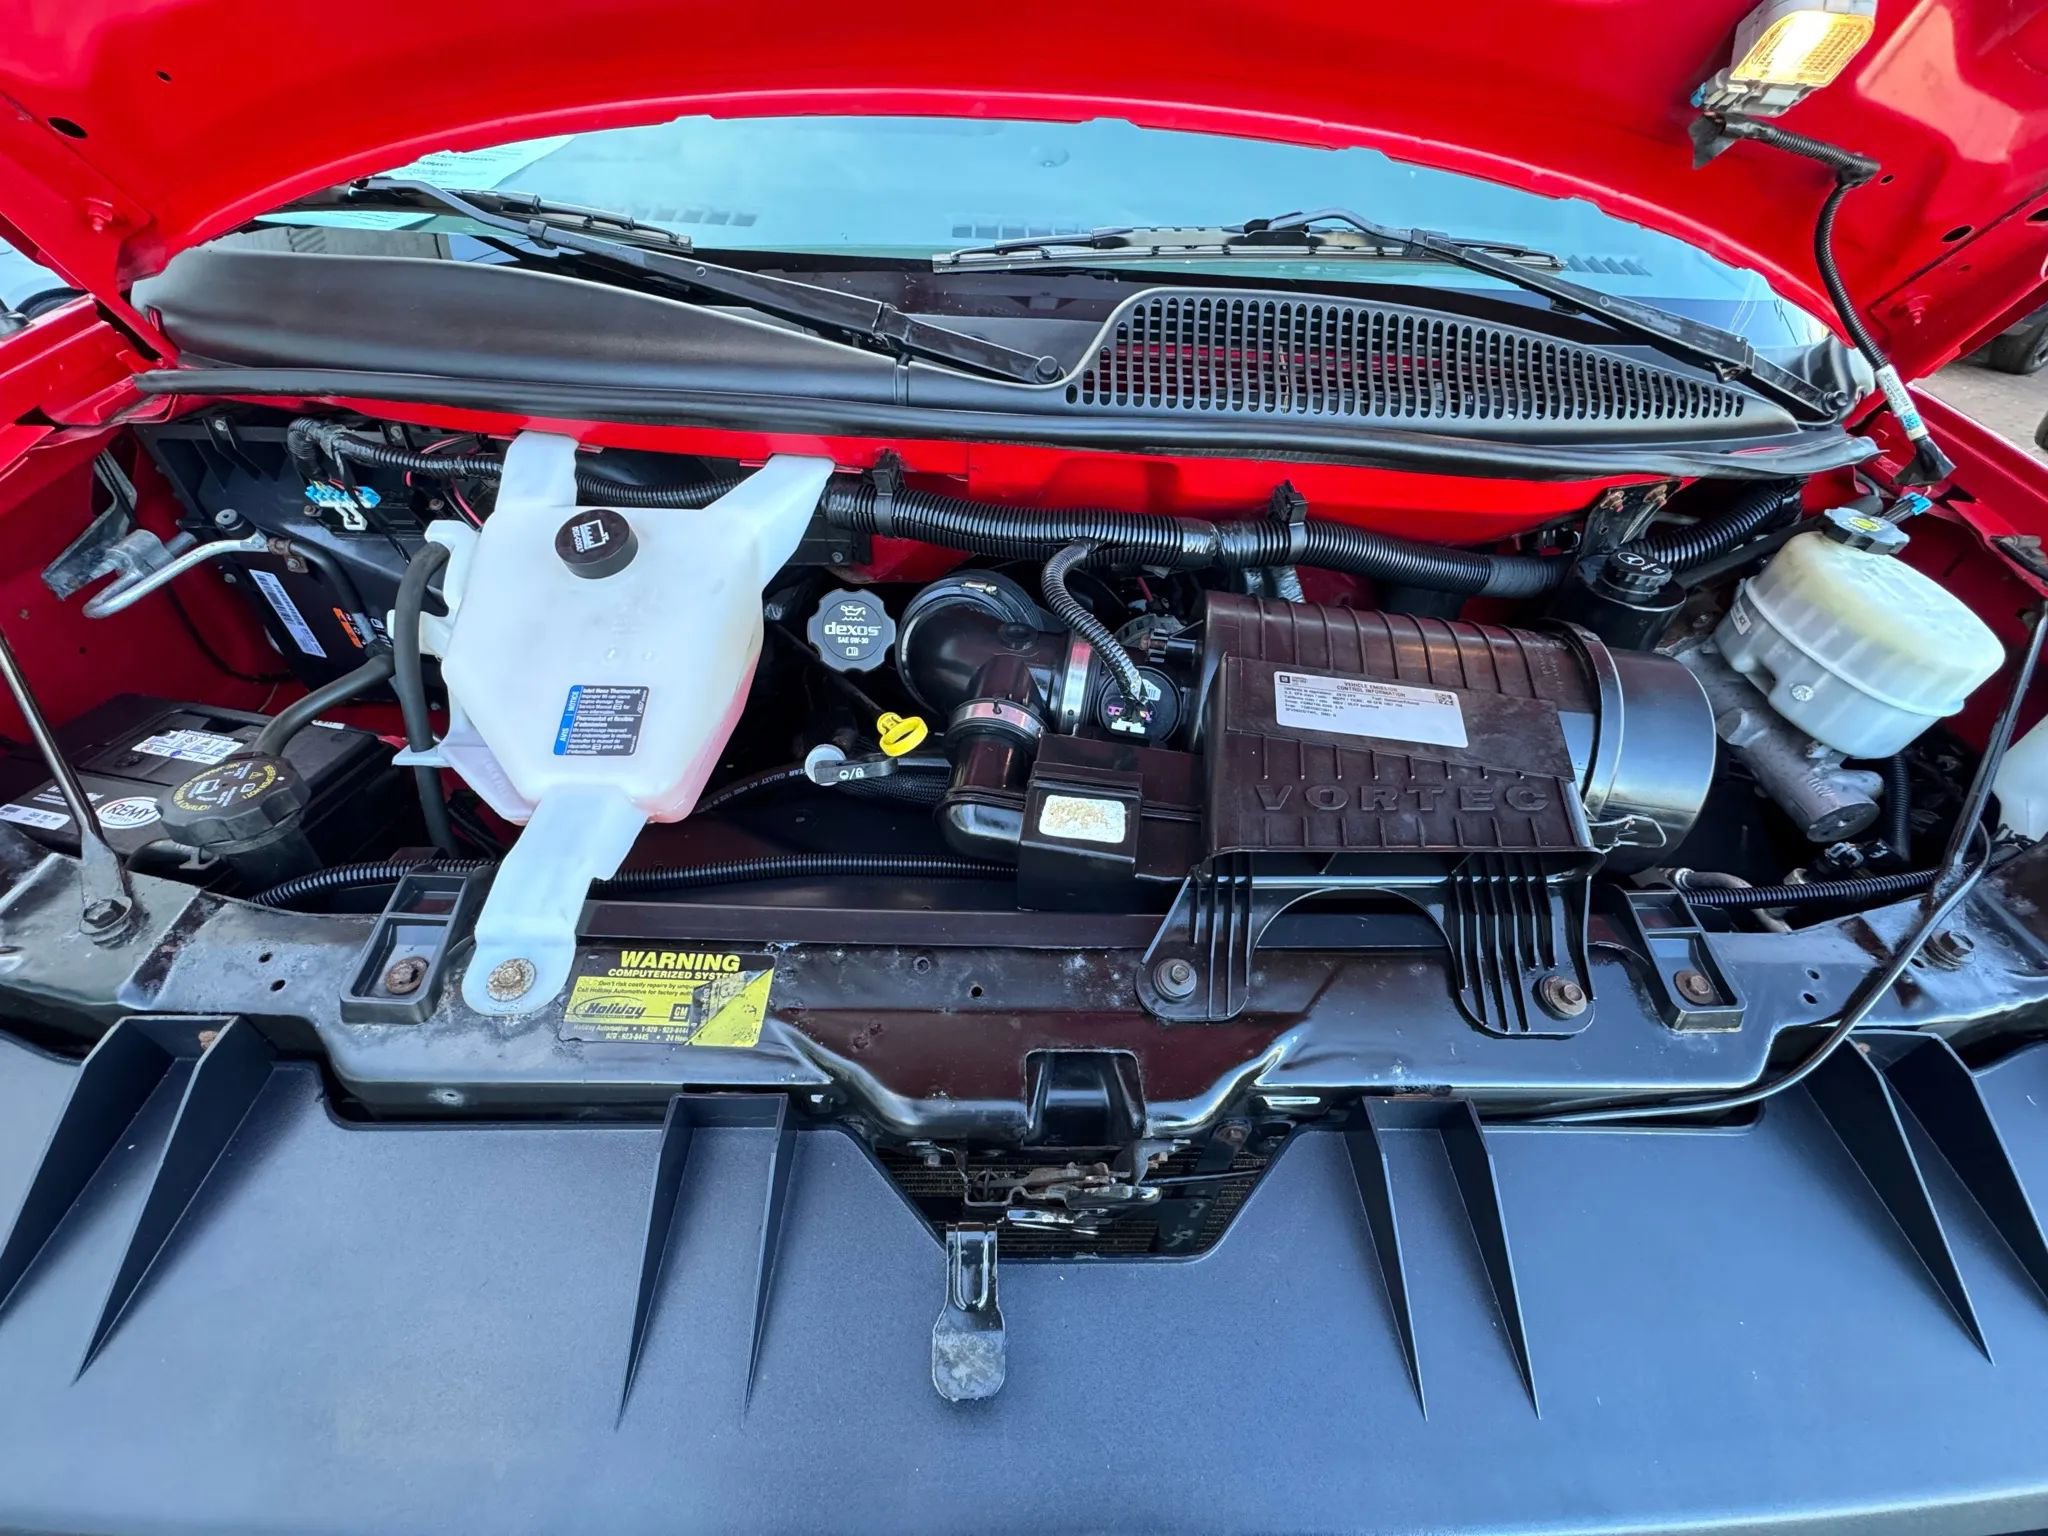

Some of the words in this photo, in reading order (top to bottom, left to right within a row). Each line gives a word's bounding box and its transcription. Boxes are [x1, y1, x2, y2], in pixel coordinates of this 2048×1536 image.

[824, 621, 882, 637] dexos
[837, 636, 850, 644] SAE
[1344, 681, 1368, 689] VEHICLE
[1369, 684, 1398, 692] EMISSION
[1365, 688, 1406, 697] INFORMATION
[567, 691, 580, 711] NOTICE
[560, 728, 570, 742] AVIS
[761, 773, 786, 784] GALAXY
[1255, 783, 1550, 812] VORTEC
[106, 804, 158, 820] REMY
[621, 950, 740, 972] WARNING
[608, 968, 693, 980] COMPUTERIZED
[585, 1003, 646, 1019] Holiday
[674, 1006, 688, 1016] GM
